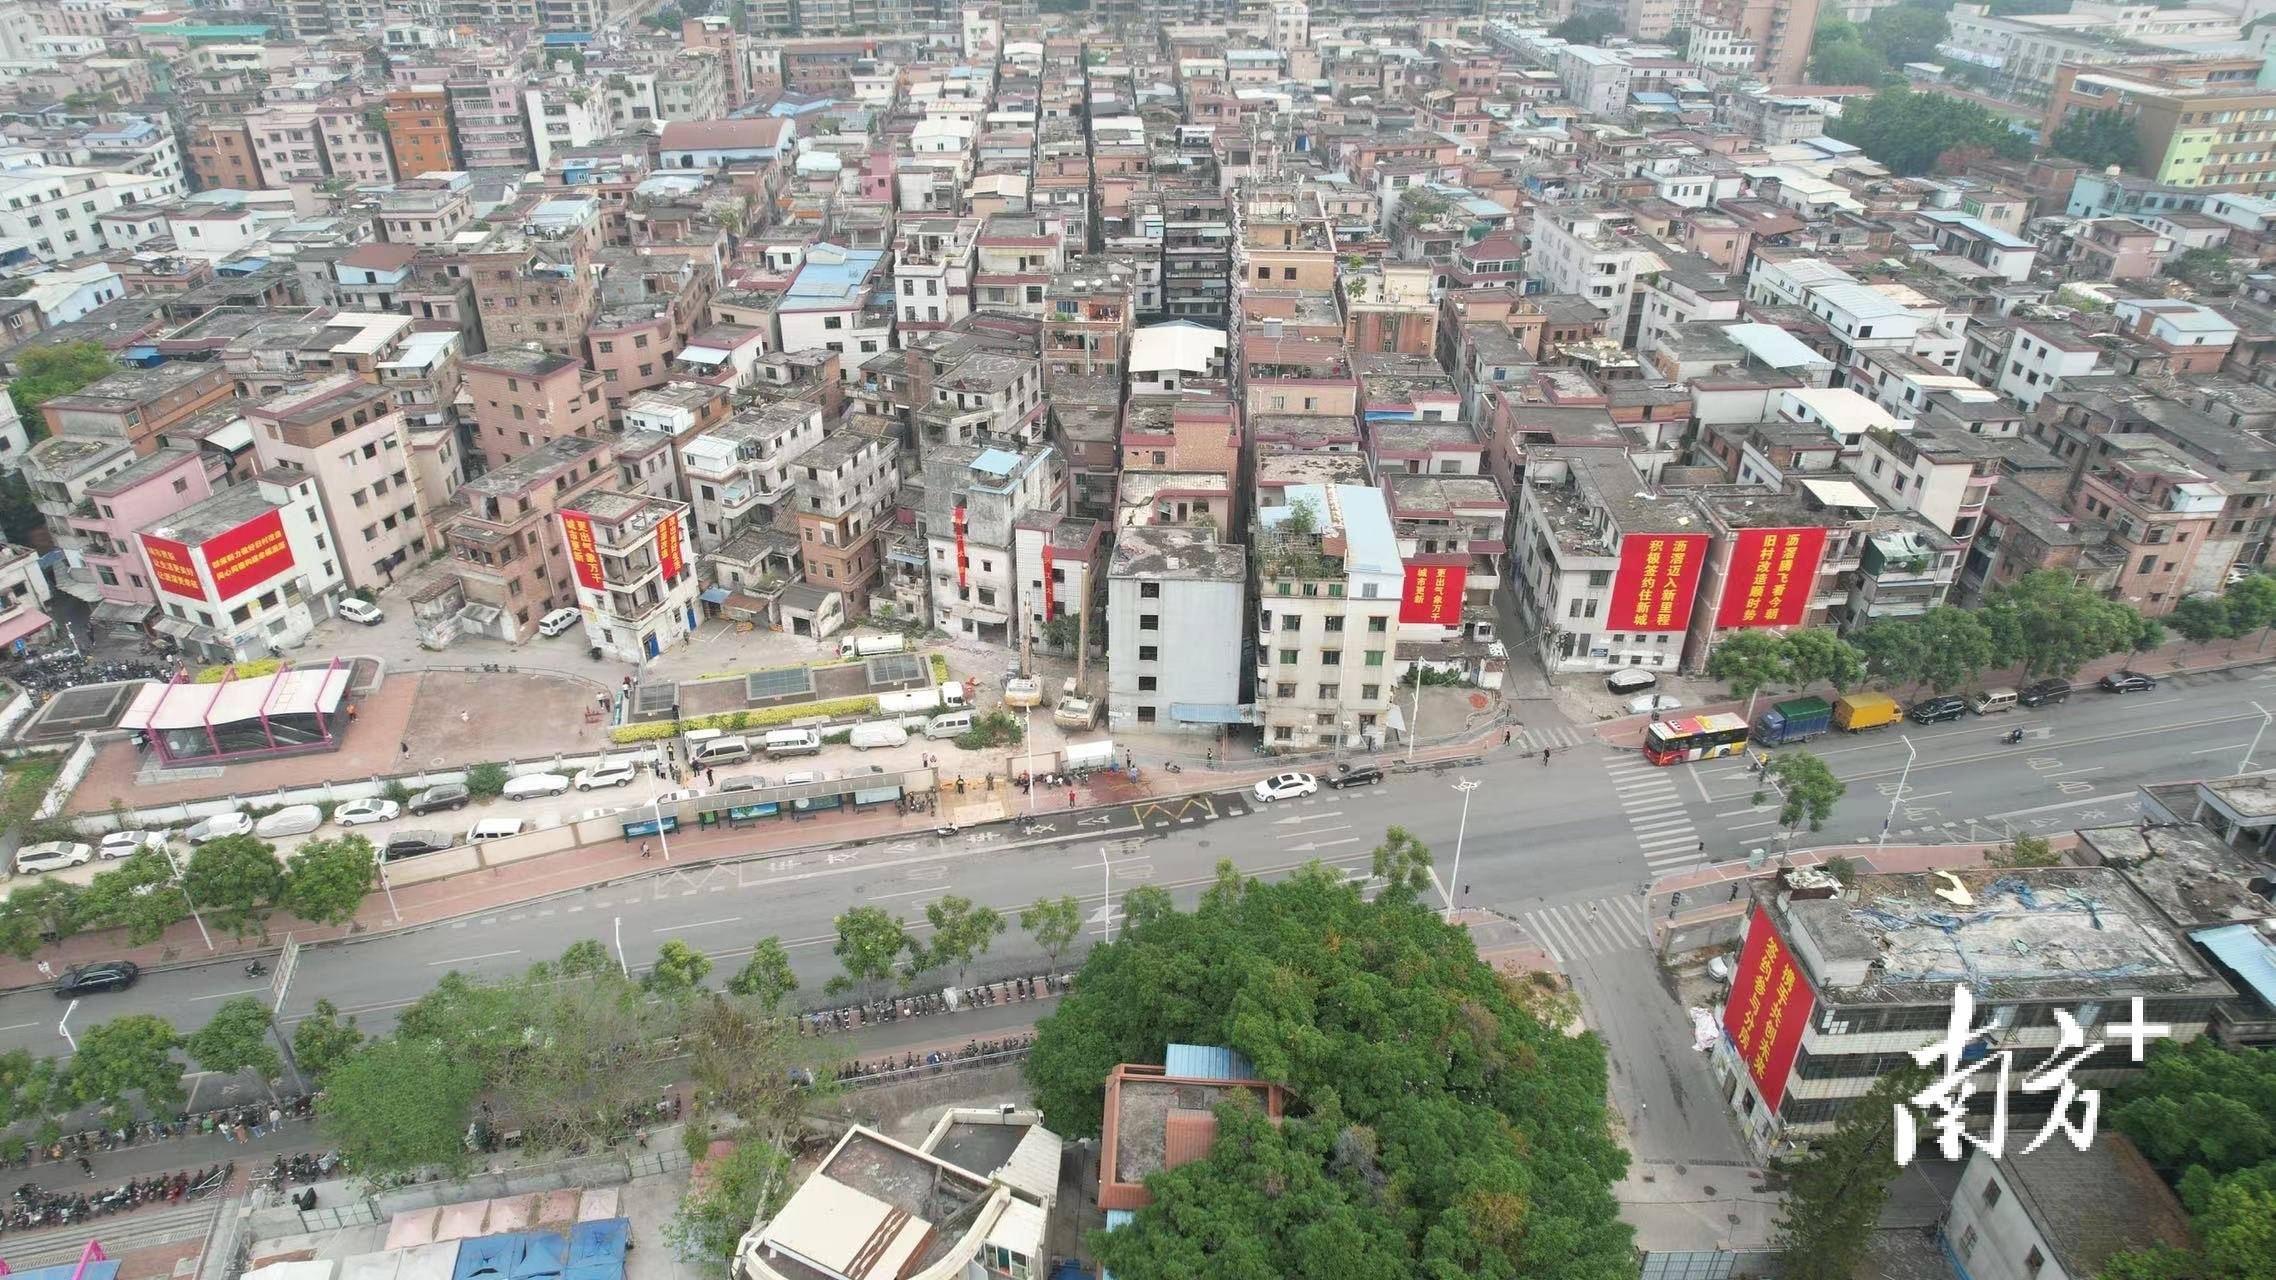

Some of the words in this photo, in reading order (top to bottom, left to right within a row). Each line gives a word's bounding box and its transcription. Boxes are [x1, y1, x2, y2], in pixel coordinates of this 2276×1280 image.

[1414, 568, 1428, 604] 城市更新
[1431, 569, 1447, 621] 更出气象万千
[1632, 539, 1664, 626] 积极签约住新城
[1655, 539, 1688, 626] 沥滘迈入新里程
[1743, 534, 1778, 620] 旧村改造顺时势
[1764, 533, 1801, 620] 沥滘腾飞看今朝
[1753, 963, 1796, 1080] 携手共创未来
